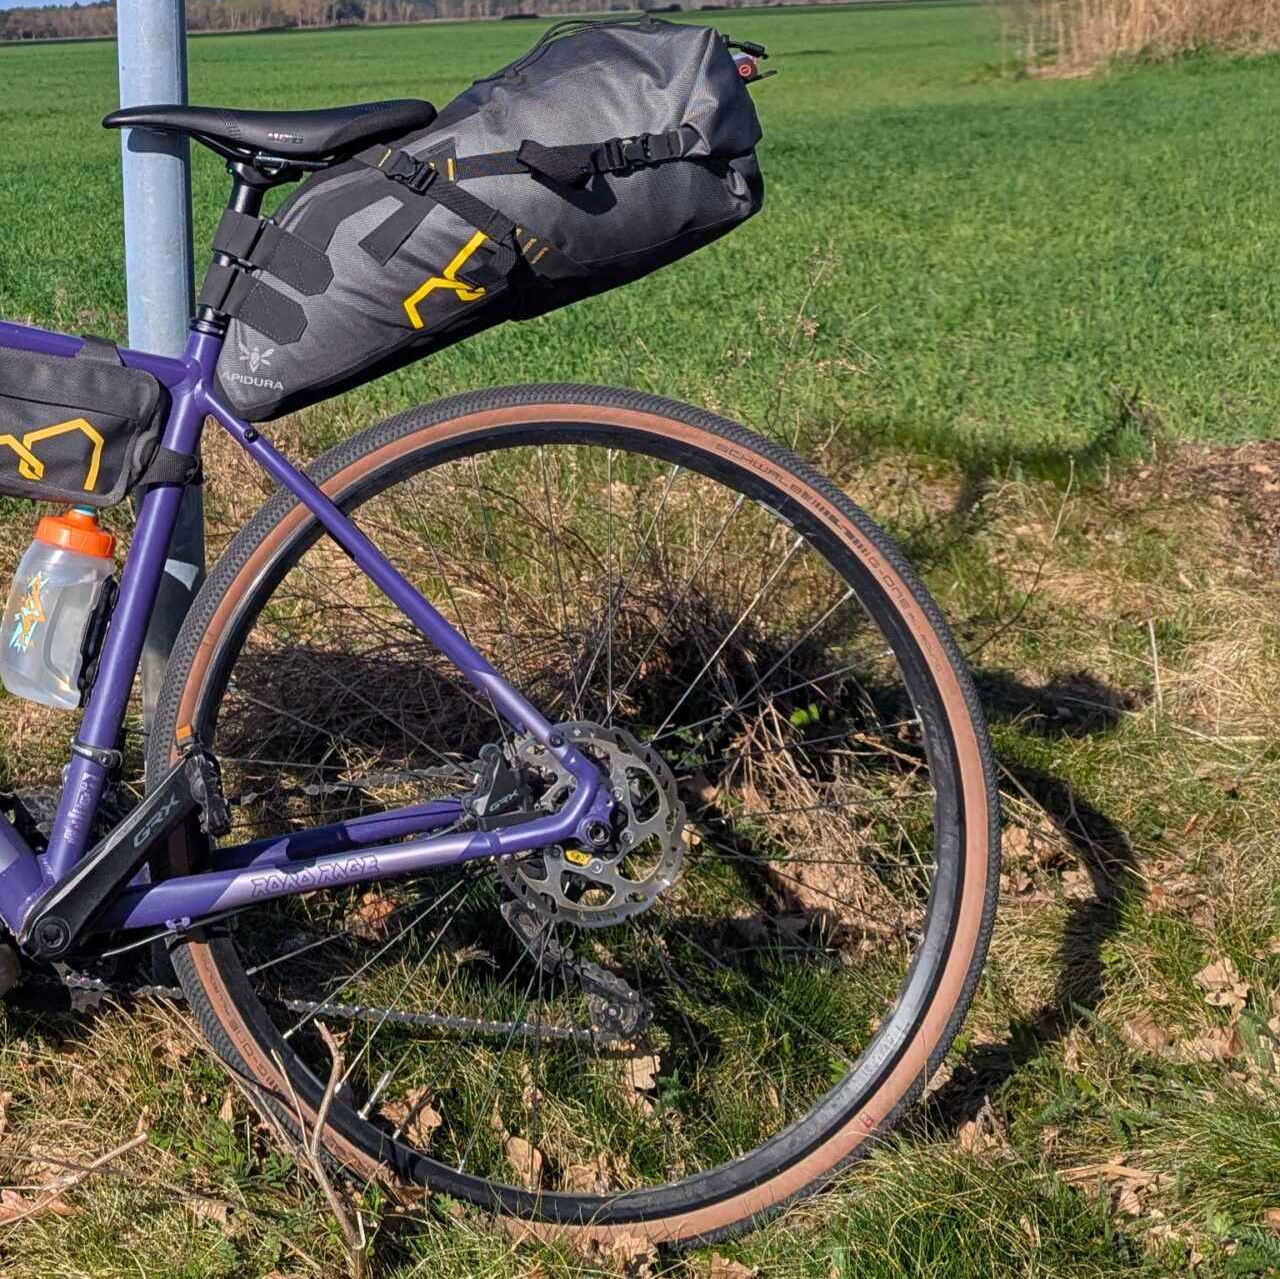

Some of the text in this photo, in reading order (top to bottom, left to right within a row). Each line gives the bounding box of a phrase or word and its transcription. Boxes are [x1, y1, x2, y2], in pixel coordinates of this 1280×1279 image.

[223, 371, 284, 390] APIDURA
[715, 443, 813, 502] SCHWALBE
[134, 793, 180, 847] GRX
[489, 789, 519, 812] GRX
[251, 855, 380, 898] ROAD RAGE
